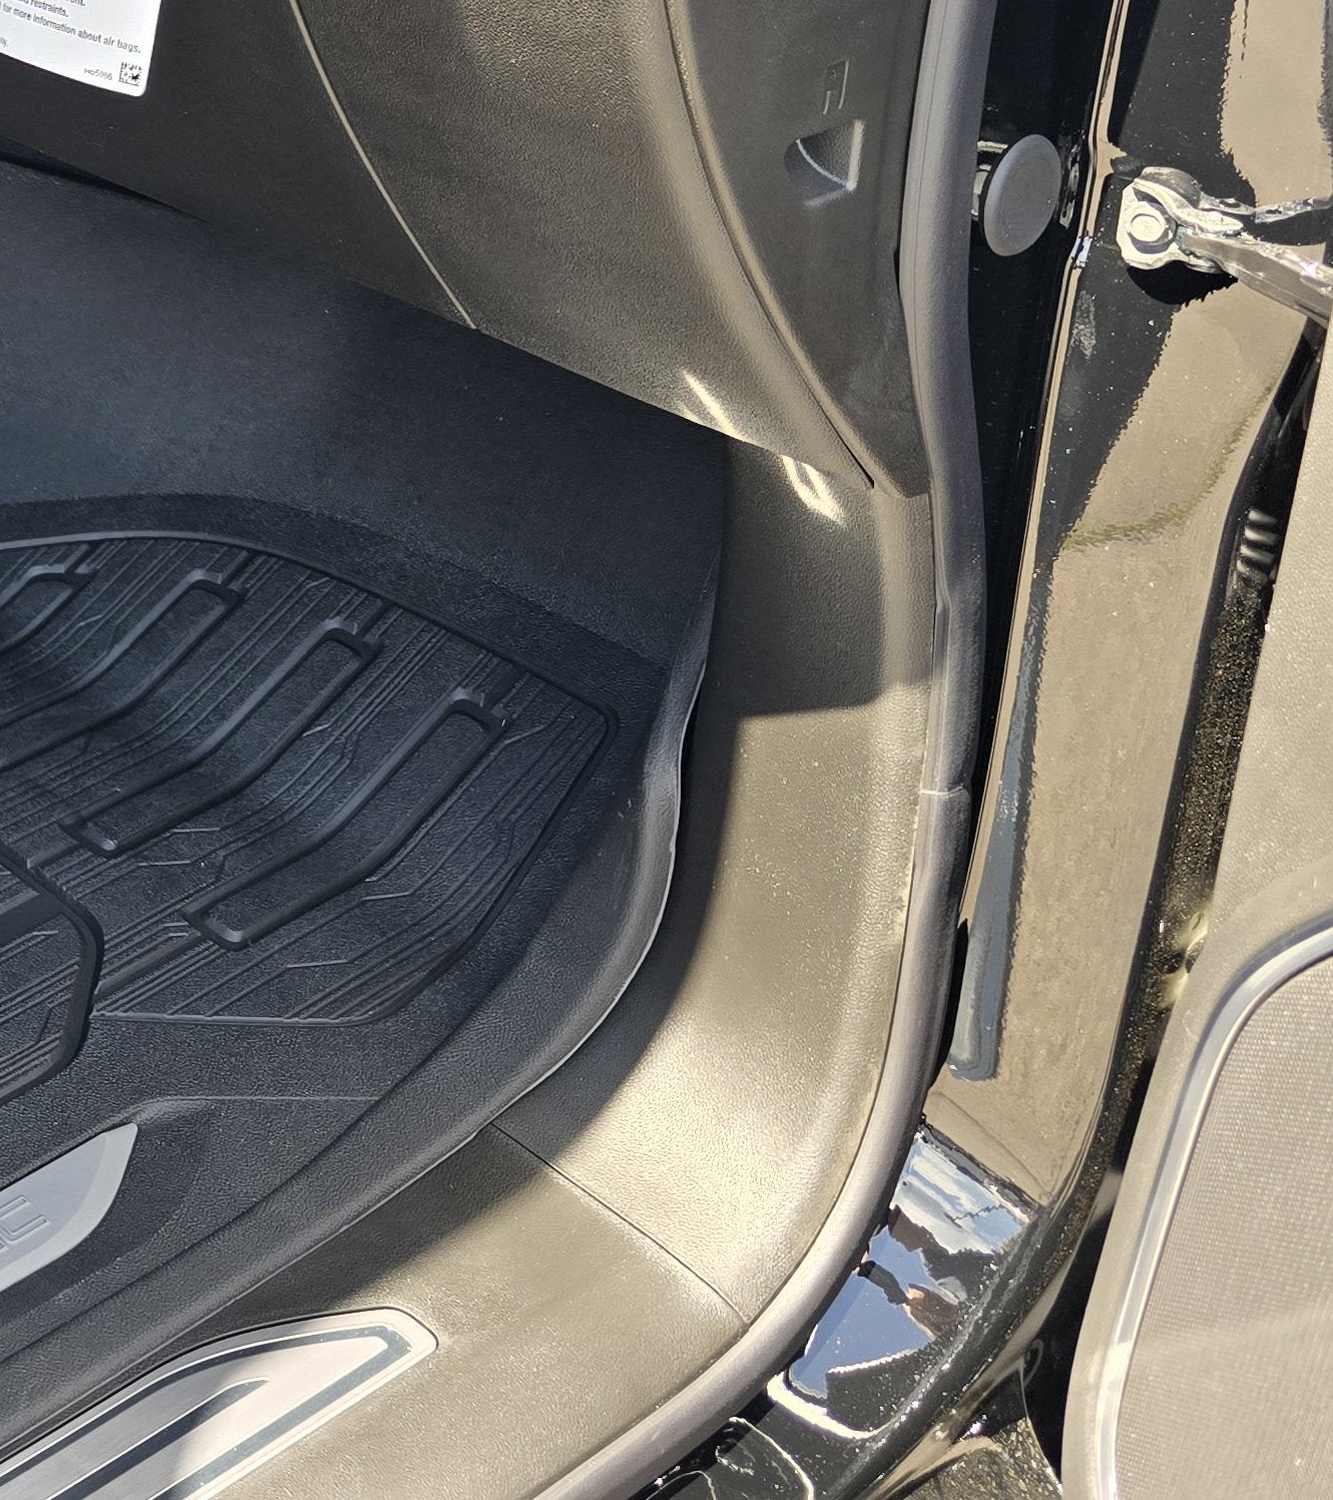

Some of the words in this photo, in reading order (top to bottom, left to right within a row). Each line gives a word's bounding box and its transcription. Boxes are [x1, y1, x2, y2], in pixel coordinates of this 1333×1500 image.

[33, 13, 76, 36] information
[78, 30, 102, 44] about
[103, 36, 116, 46] air
[117, 39, 141, 54] bags.
